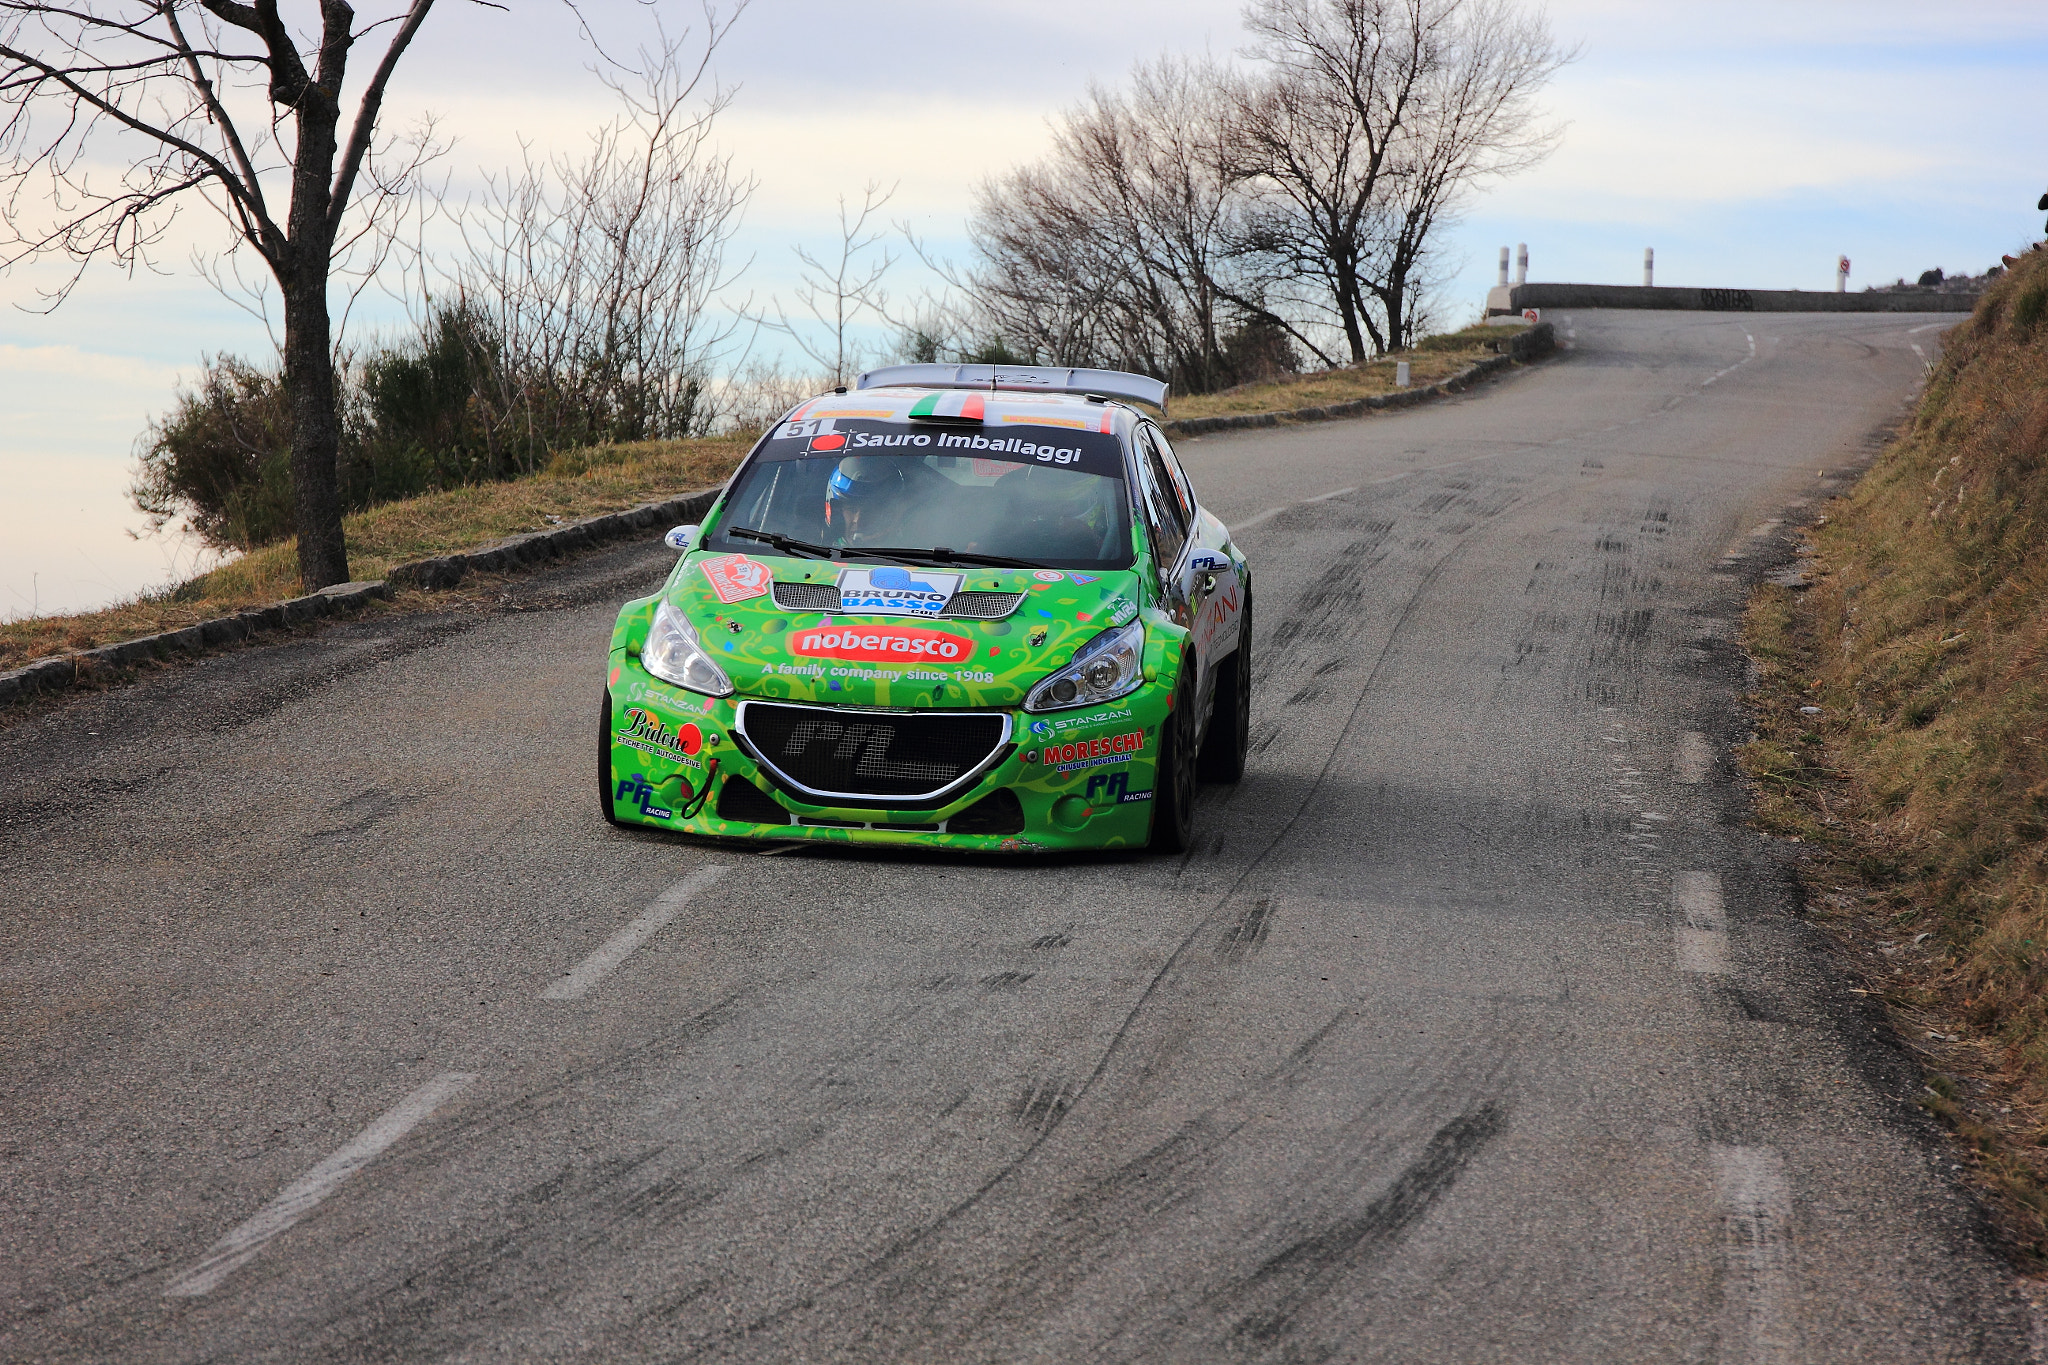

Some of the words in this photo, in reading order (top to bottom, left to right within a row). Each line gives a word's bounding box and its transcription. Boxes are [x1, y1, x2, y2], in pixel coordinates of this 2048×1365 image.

[787, 419, 822, 437] 51
[853, 432, 931, 448] Sauro
[937, 432, 1082, 465] Imballaggi
[842, 598, 944, 611] BASSO
[843, 590, 947, 602] BRUNO
[1110, 600, 1138, 626] MV24
[801, 631, 959, 658] noberasco
[761, 663, 773, 674] A
[777, 663, 826, 679] family
[830, 667, 902, 683] company
[907, 669, 948, 682] since
[954, 670, 994, 684] 1908
[644, 690, 709, 716] STANZANI
[1055, 709, 1132, 730] STANZANI
[619, 707, 690, 755] Bidone
[617, 736, 654, 754] ETICHETTE
[656, 749, 701, 769] AUTOADESIVE
[1044, 731, 1144, 765] MORESCHI
[1057, 760, 1089, 772] CHIUSURE
[1090, 753, 1132, 767] INDUSTRIALI
[1123, 791, 1152, 801] RACING
[645, 806, 671, 818] RACING
